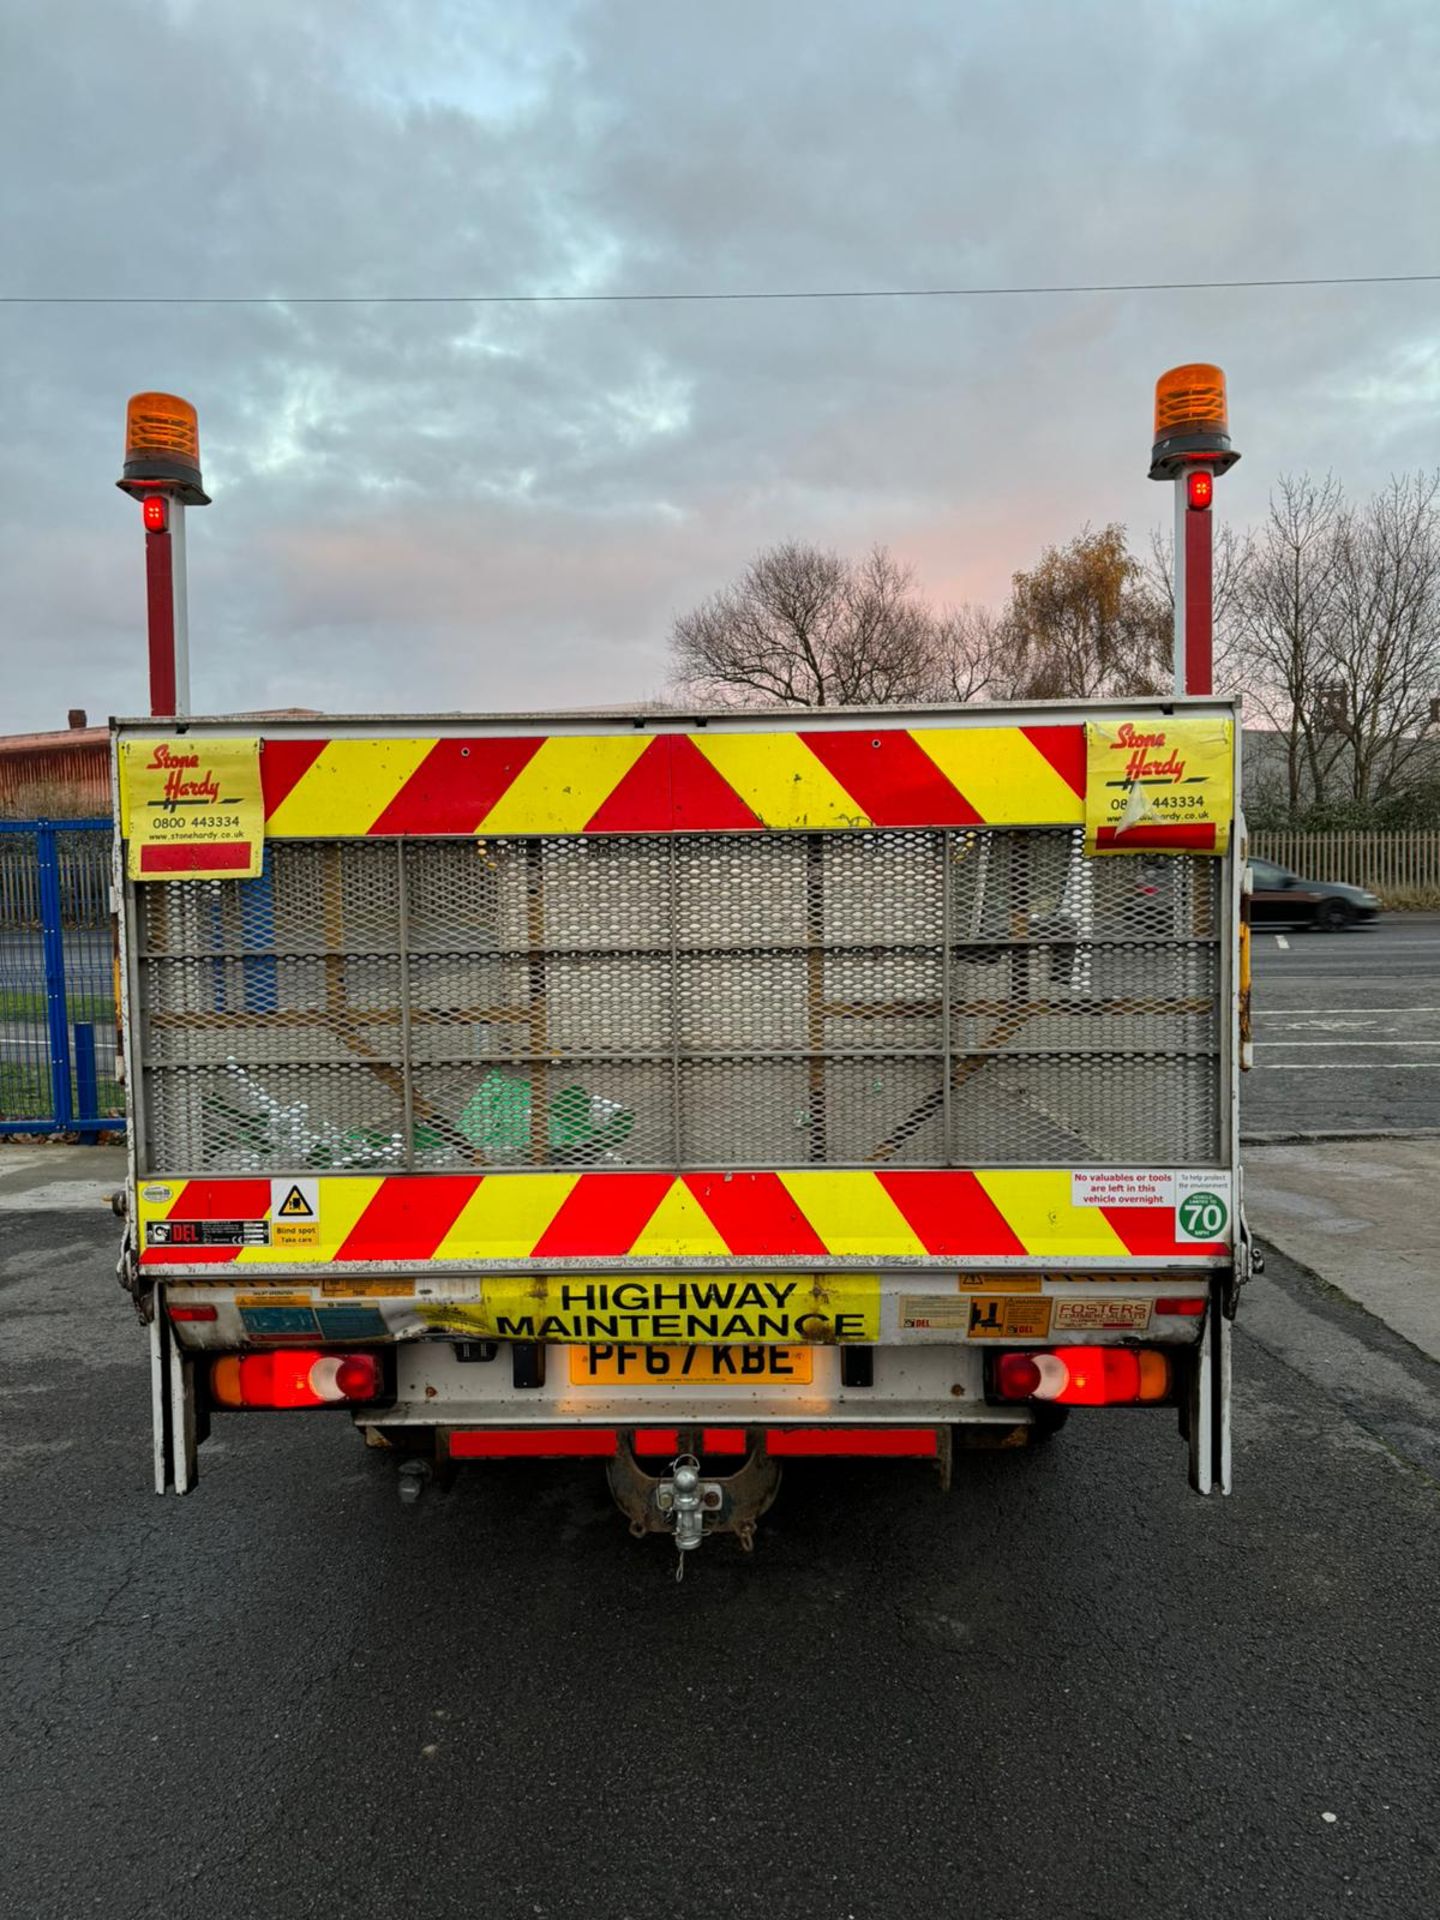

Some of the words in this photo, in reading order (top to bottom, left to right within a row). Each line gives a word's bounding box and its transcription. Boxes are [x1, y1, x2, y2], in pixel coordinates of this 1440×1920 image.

[1109, 723, 1166, 749] Stone
[146, 744, 199, 769] Stone
[1126, 749, 1186, 783] Hardy
[163, 769, 220, 803] Hardy
[1152, 796, 1204, 808] 443334
[152, 817, 186, 829] 0800
[191, 816, 240, 828] 443334
[149, 831, 245, 841] www.stonehardy.co.uk
[1074, 1174, 1087, 1182] No
[1090, 1174, 1133, 1182] valuables
[1149, 1174, 1172, 1182] tools
[1190, 1174, 1202, 1183] help
[1108, 1184, 1124, 1192] left
[1126, 1184, 1135, 1192] in
[1138, 1184, 1156, 1192] this
[1083, 1195, 1116, 1203] vehicle
[1118, 1195, 1164, 1204] overnight
[1184, 1205, 1222, 1231] 70
[173, 1224, 198, 1242] DEL
[299, 1227, 316, 1235] spot
[561, 1282, 798, 1310] HIGHWAY
[1060, 1303, 1147, 1314] FOSTERS
[496, 1314, 865, 1338] MAINTENANCE
[588, 1344, 698, 1375] PF67
[712, 1344, 794, 1374] KBE
